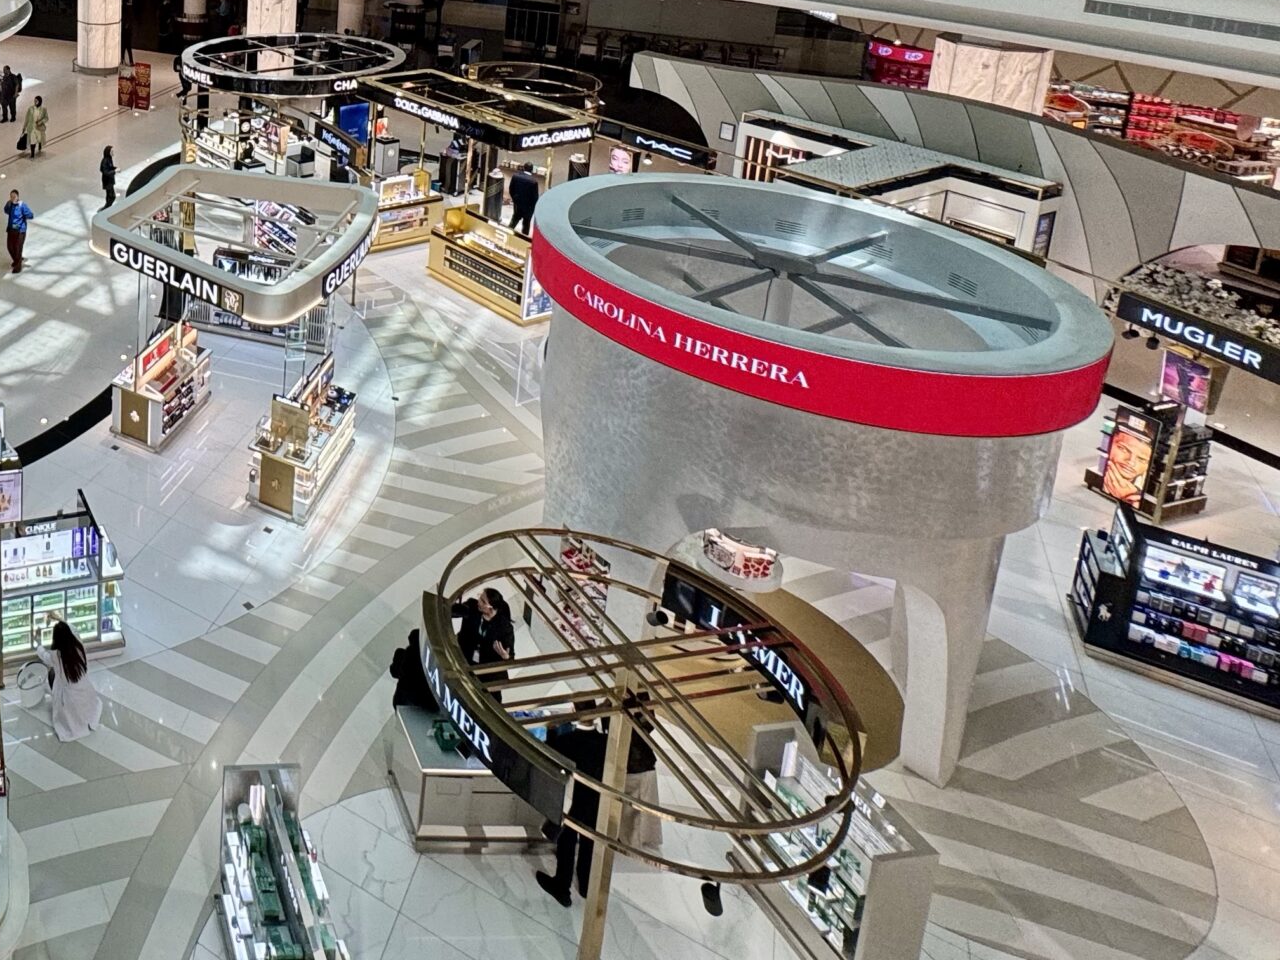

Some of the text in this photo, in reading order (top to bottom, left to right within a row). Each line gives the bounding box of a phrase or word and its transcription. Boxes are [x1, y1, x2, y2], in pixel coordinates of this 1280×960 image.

[113, 242, 218, 305] GUERLAIN
[573, 283, 810, 389] CAROLINA HERRERA
[1141, 307, 1262, 370] MUGLER
[25, 522, 57, 535] CLINIQUE
[1171, 538, 1259, 569] RALPH LAUREN
[425, 646, 493, 763] LA MER
[850, 791, 872, 820] ER
